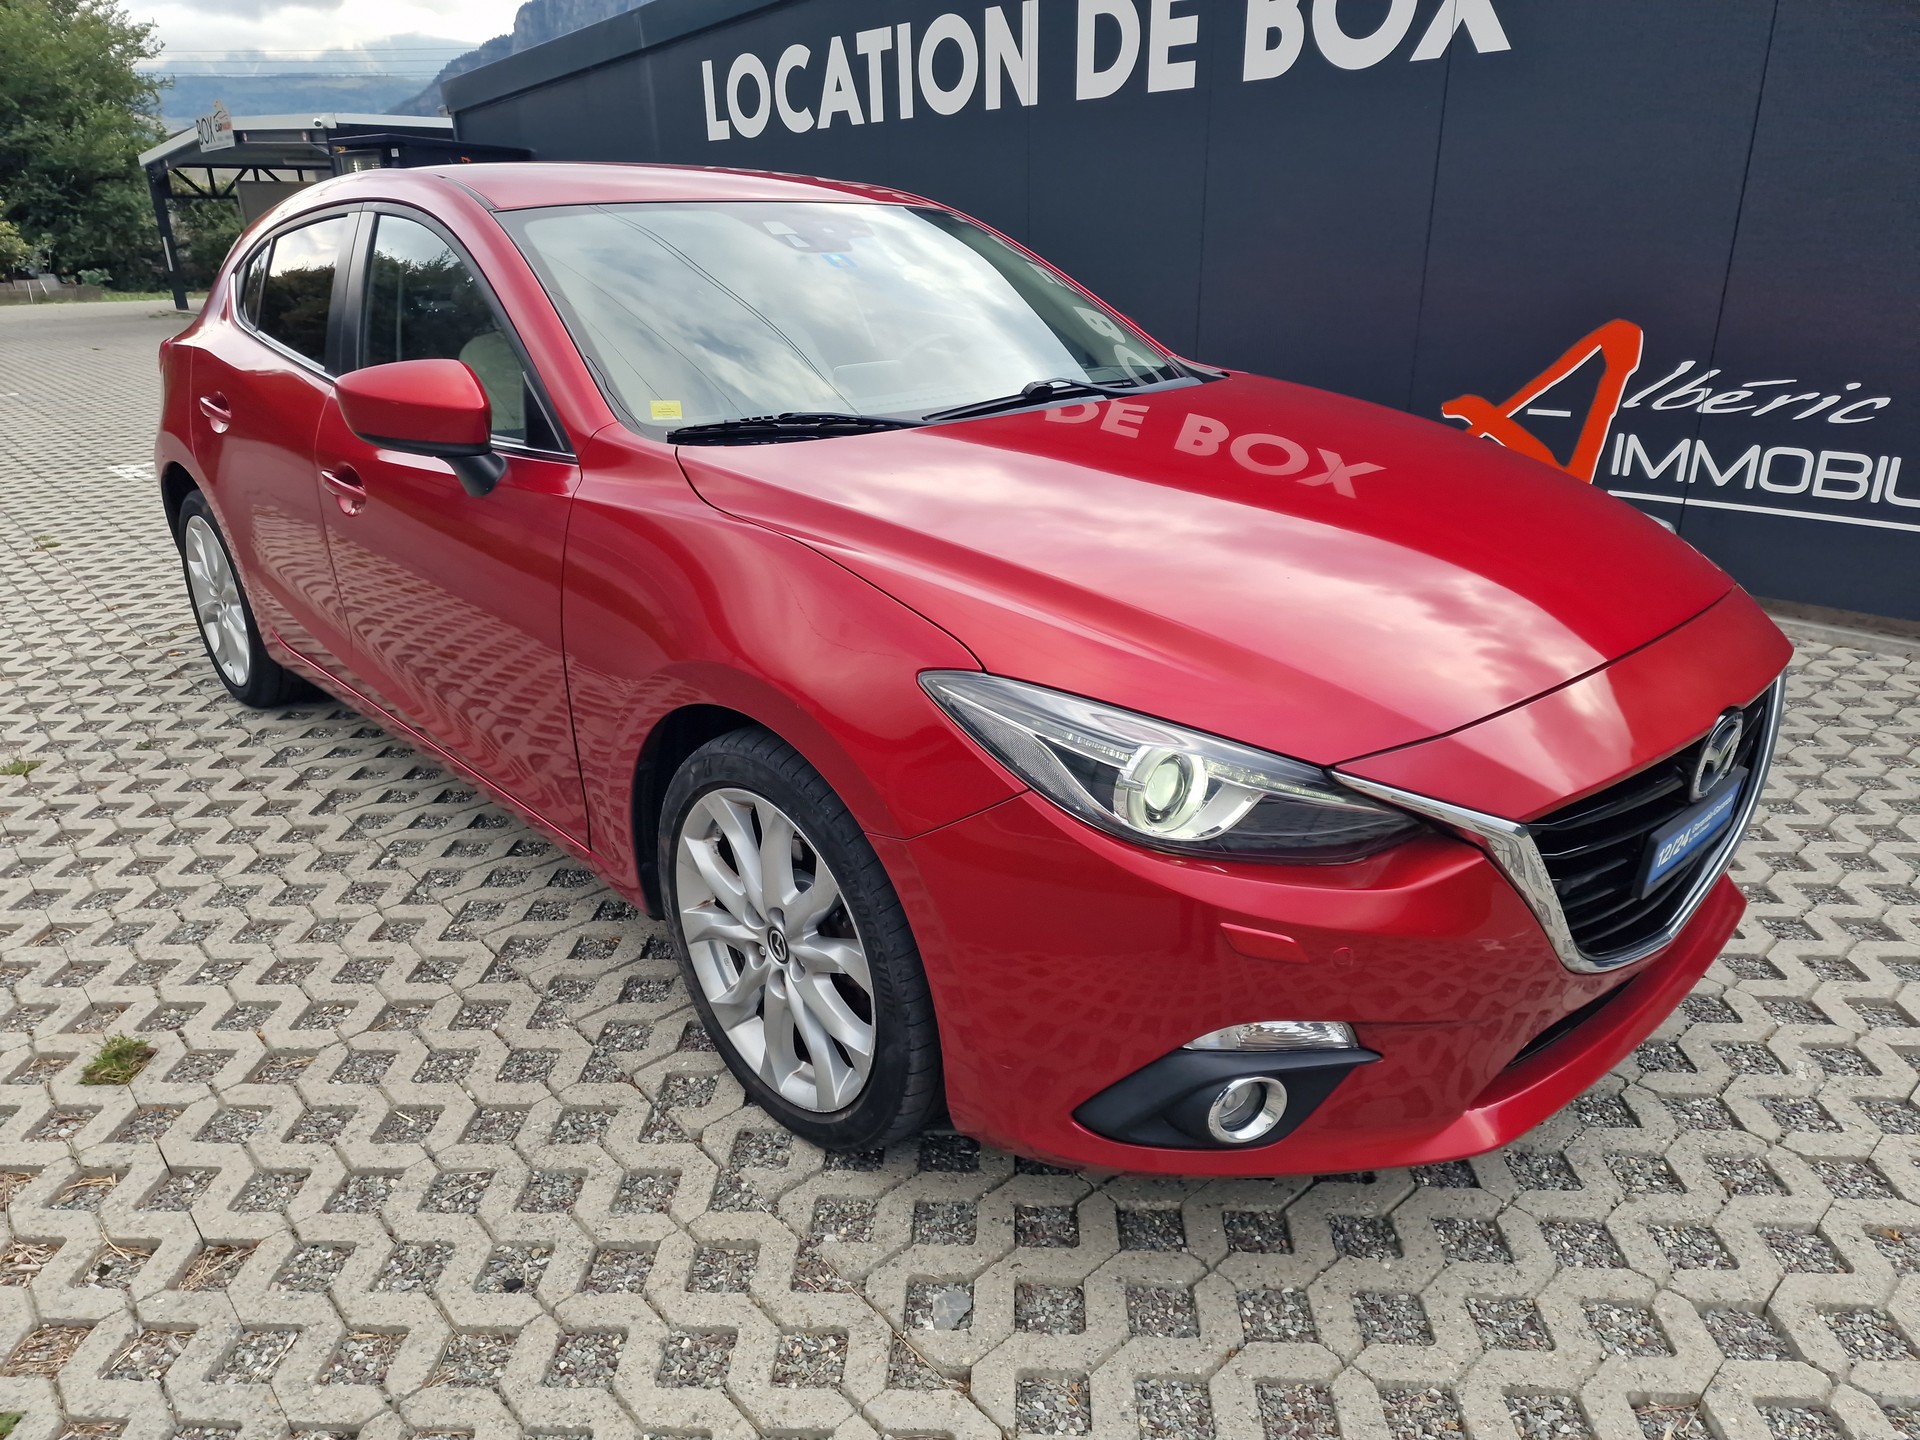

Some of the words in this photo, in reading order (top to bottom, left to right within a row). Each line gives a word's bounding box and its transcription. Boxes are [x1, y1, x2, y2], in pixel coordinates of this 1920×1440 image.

[702, 0, 1038, 141] LOCATION
[1076, 0, 1199, 100] DE
[196, 116, 216, 146] BOX
